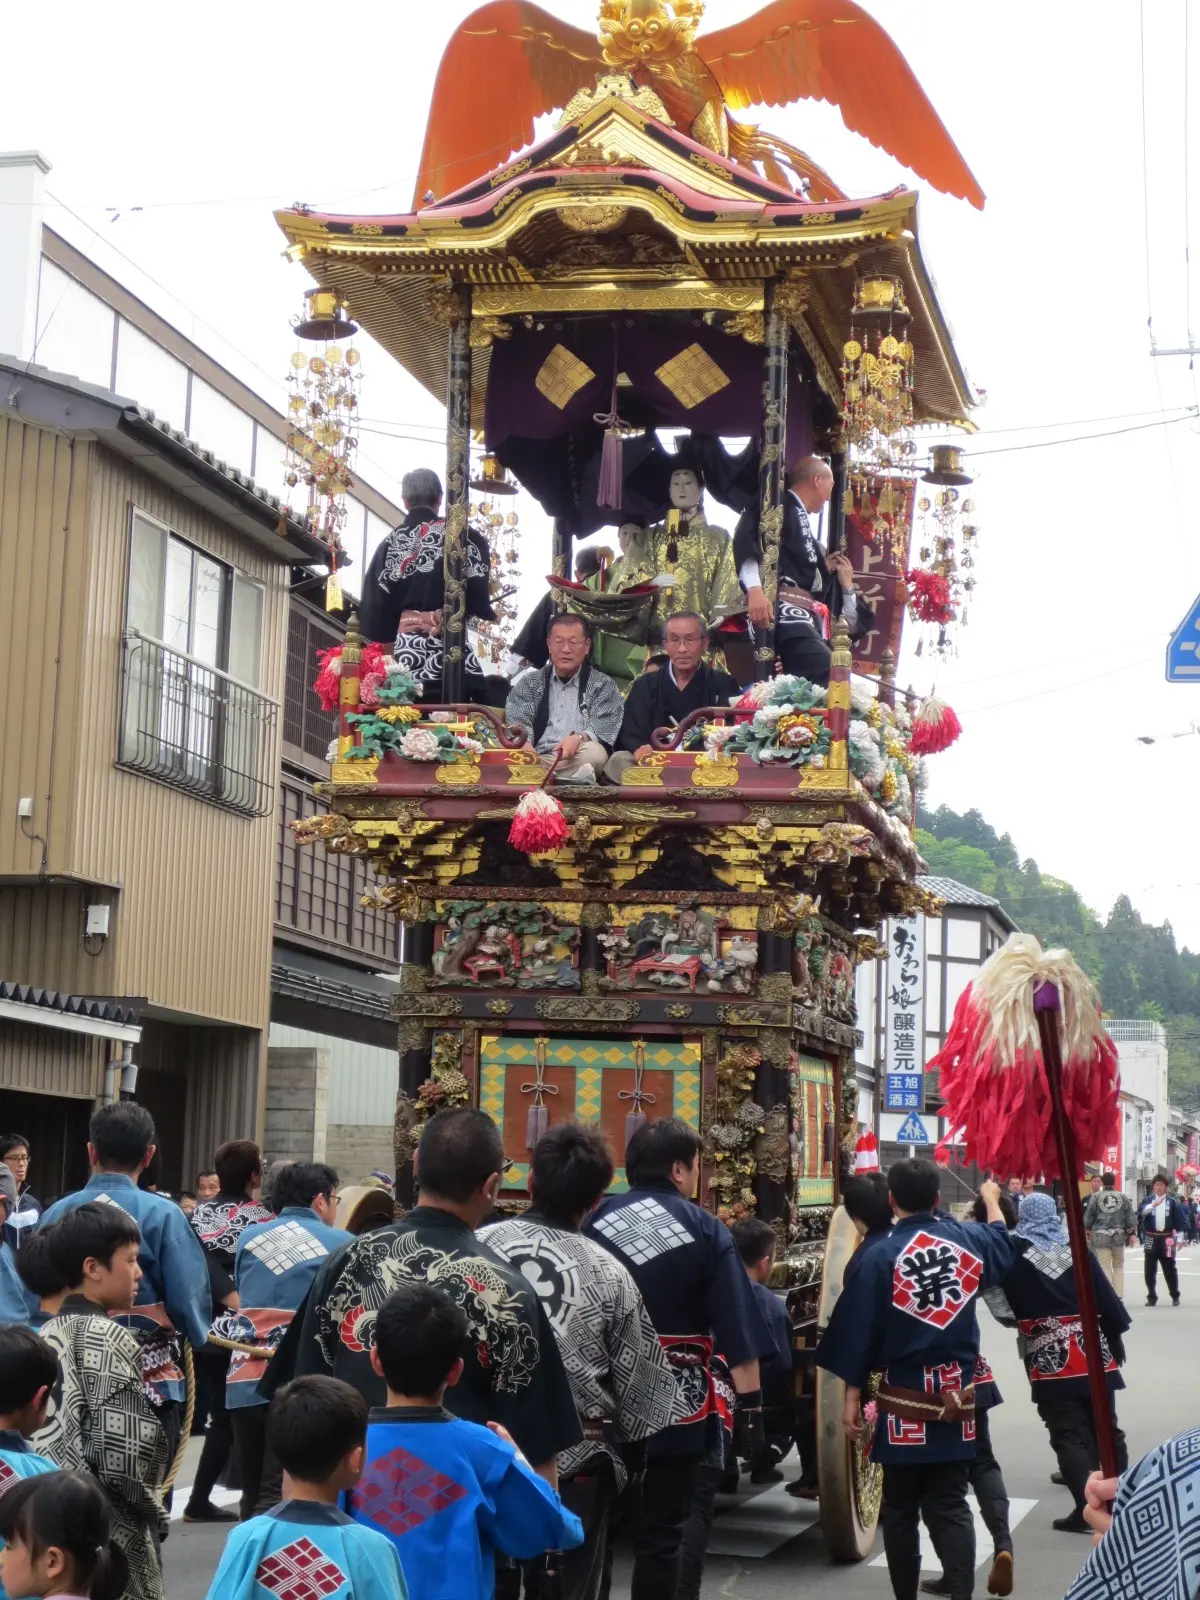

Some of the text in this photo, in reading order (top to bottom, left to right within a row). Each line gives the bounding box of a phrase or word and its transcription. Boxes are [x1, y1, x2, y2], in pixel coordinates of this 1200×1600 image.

[889, 1076, 919, 1089] 玉旭
[889, 1093, 919, 1106] 酒造
[901, 1245, 963, 1312] 業
